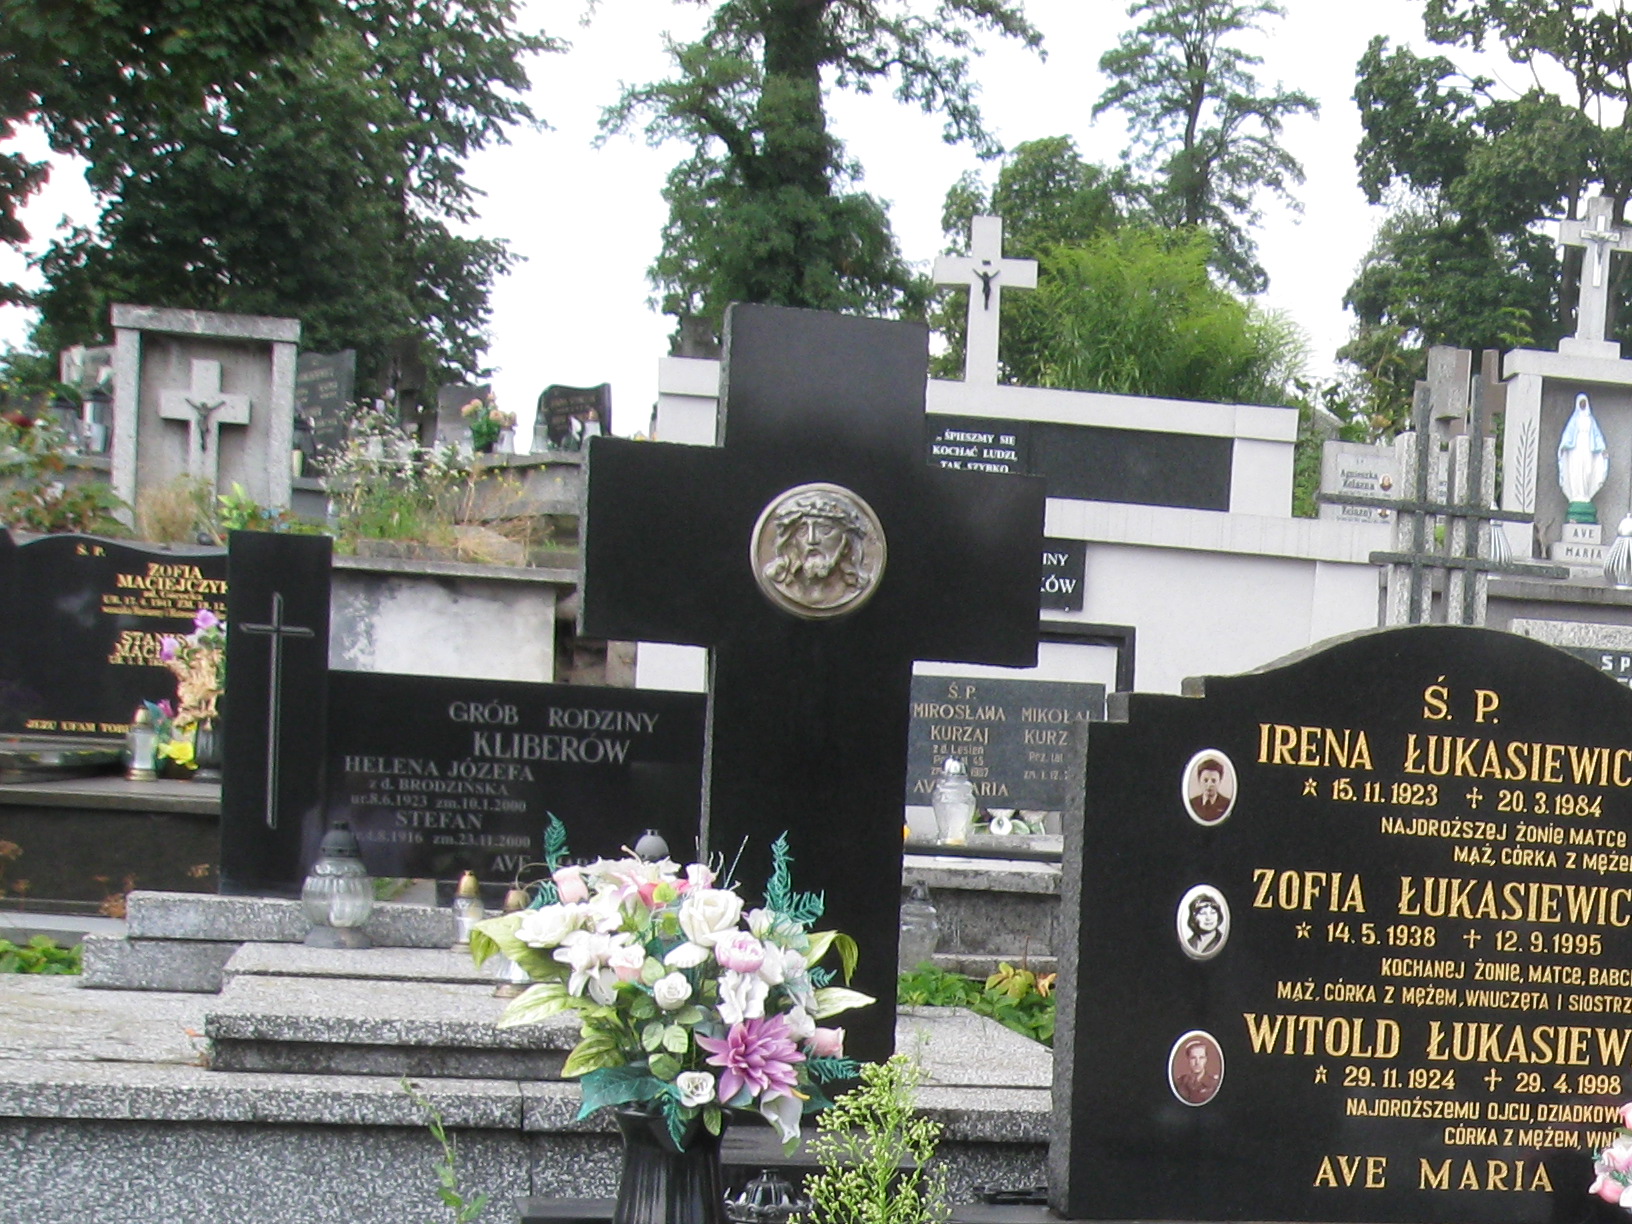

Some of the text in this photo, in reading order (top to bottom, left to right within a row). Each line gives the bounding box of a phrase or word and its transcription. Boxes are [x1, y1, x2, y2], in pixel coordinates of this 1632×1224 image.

[1572, 528, 1595, 539] AVE
[1565, 548, 1604, 560] MARIA
[147, 562, 204, 580] ZOFIA
[913, 702, 1006, 722] MIROSŁAWA
[1423, 675, 1500, 725] Ś. P.
[448, 699, 660, 734] GRÓB RODZINY
[930, 724, 990, 744] KURZAJ
[1024, 729, 1069, 746] KURZ
[472, 730, 631, 765] KLIBERÓW
[1257, 722, 1374, 772] IRENA
[343, 754, 535, 783] HELENA JÓZEFA
[399, 778, 510, 797] BRODZIŃSKA
[972, 781, 1009, 797] ARIA
[396, 811, 484, 831] STEFAN
[491, 854, 532, 873] AVE
[1501, 844, 1558, 869] CÓRKA
[1252, 868, 1367, 914] ZOFIA
[1324, 978, 1377, 1003] CÓRKA
[1242, 1012, 1400, 1061] WITOLD
[1444, 1123, 1499, 1147] CÓRKA
[1503, 1127, 1514, 1147] Z
[1313, 1154, 1555, 1193] AVE MARIA
